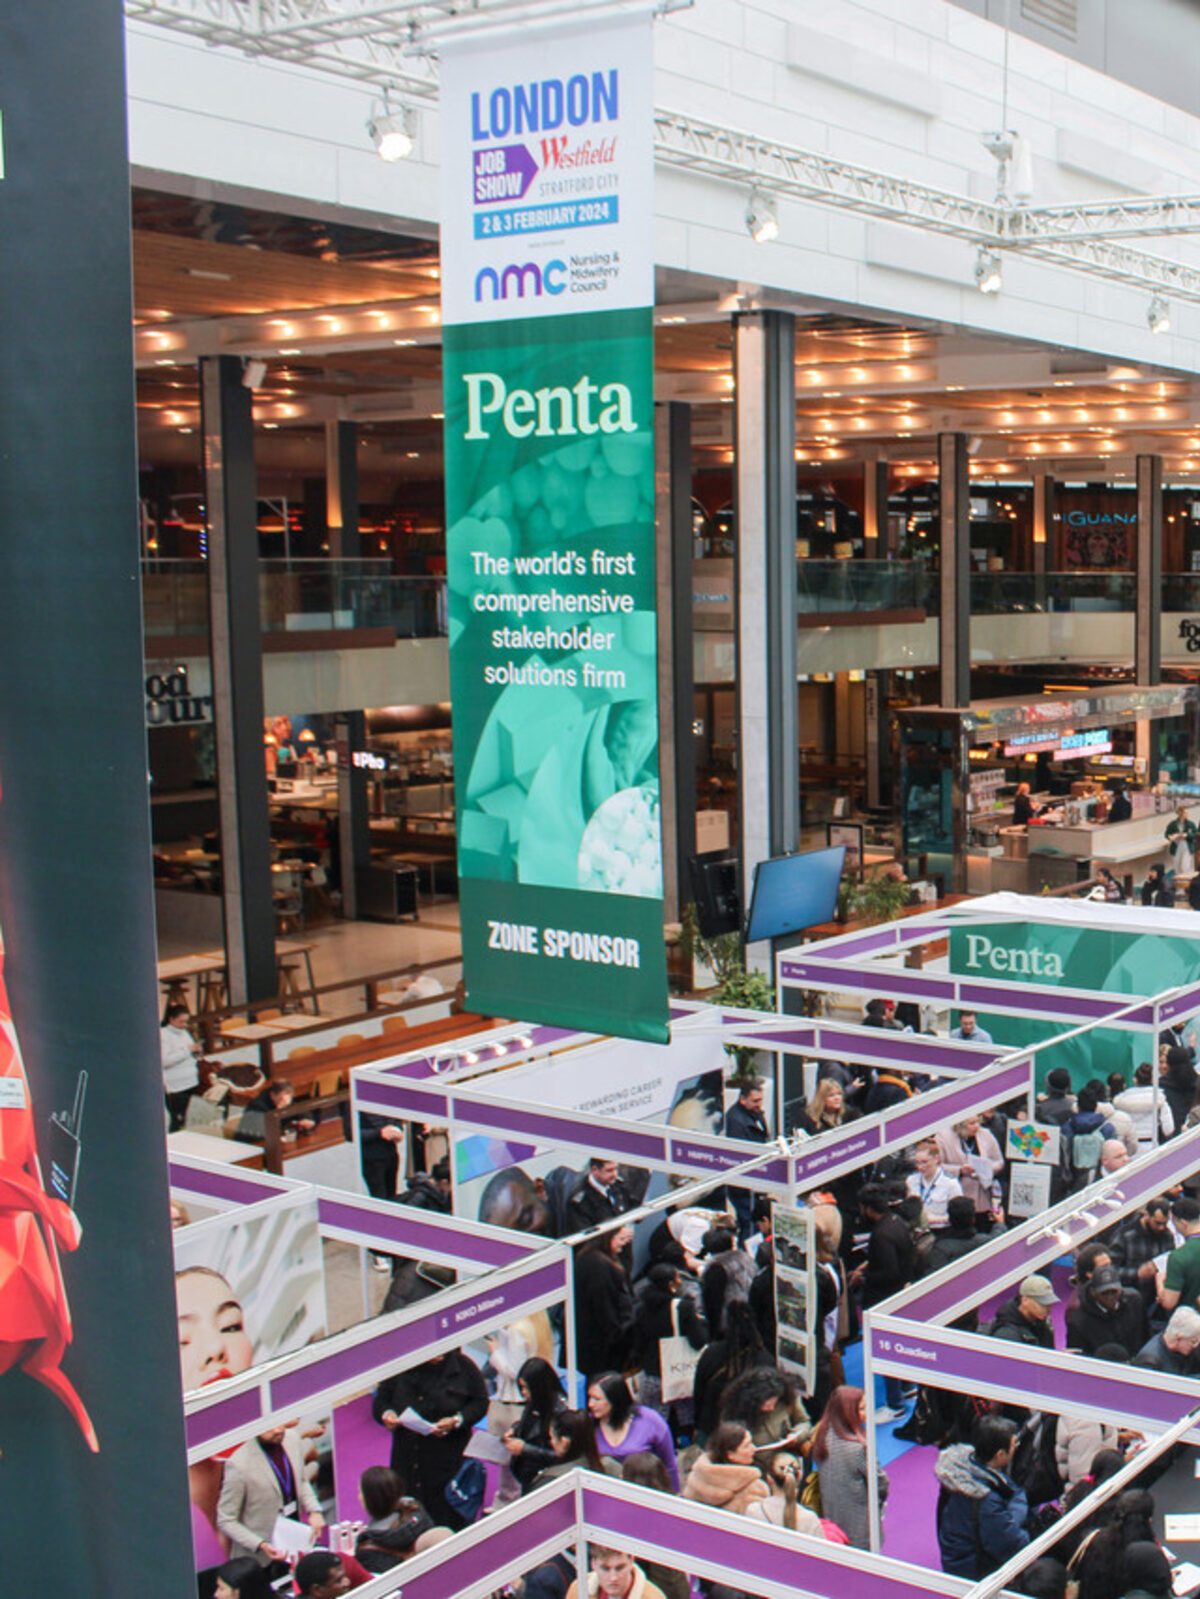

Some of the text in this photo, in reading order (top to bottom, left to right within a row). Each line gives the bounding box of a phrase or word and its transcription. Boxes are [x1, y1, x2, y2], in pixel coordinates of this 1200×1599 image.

[471, 69, 618, 141] LONDON
[476, 151, 506, 176] JOB
[540, 136, 617, 171] Westfield
[476, 172, 522, 200] SHOW
[539, 174, 619, 197] STRATFORD CITY
[482, 202, 609, 233] 2 & 3 FEBRUARY 2024
[570, 252, 619, 267] Nursing &
[570, 266, 619, 280] Midwifery
[474, 259, 567, 302] nmc
[570, 280, 607, 292] Council
[462, 372, 638, 440] Penta
[471, 551, 509, 575] The
[591, 549, 635, 575] first
[474, 589, 633, 617] comprehensive
[492, 626, 614, 649] stakeholder
[484, 662, 625, 688] solutions firm
[488, 920, 640, 968] ZONE SPONSOR
[965, 934, 1064, 978] Penta
[442, 1296, 505, 1328] 5 KIKO Milano
